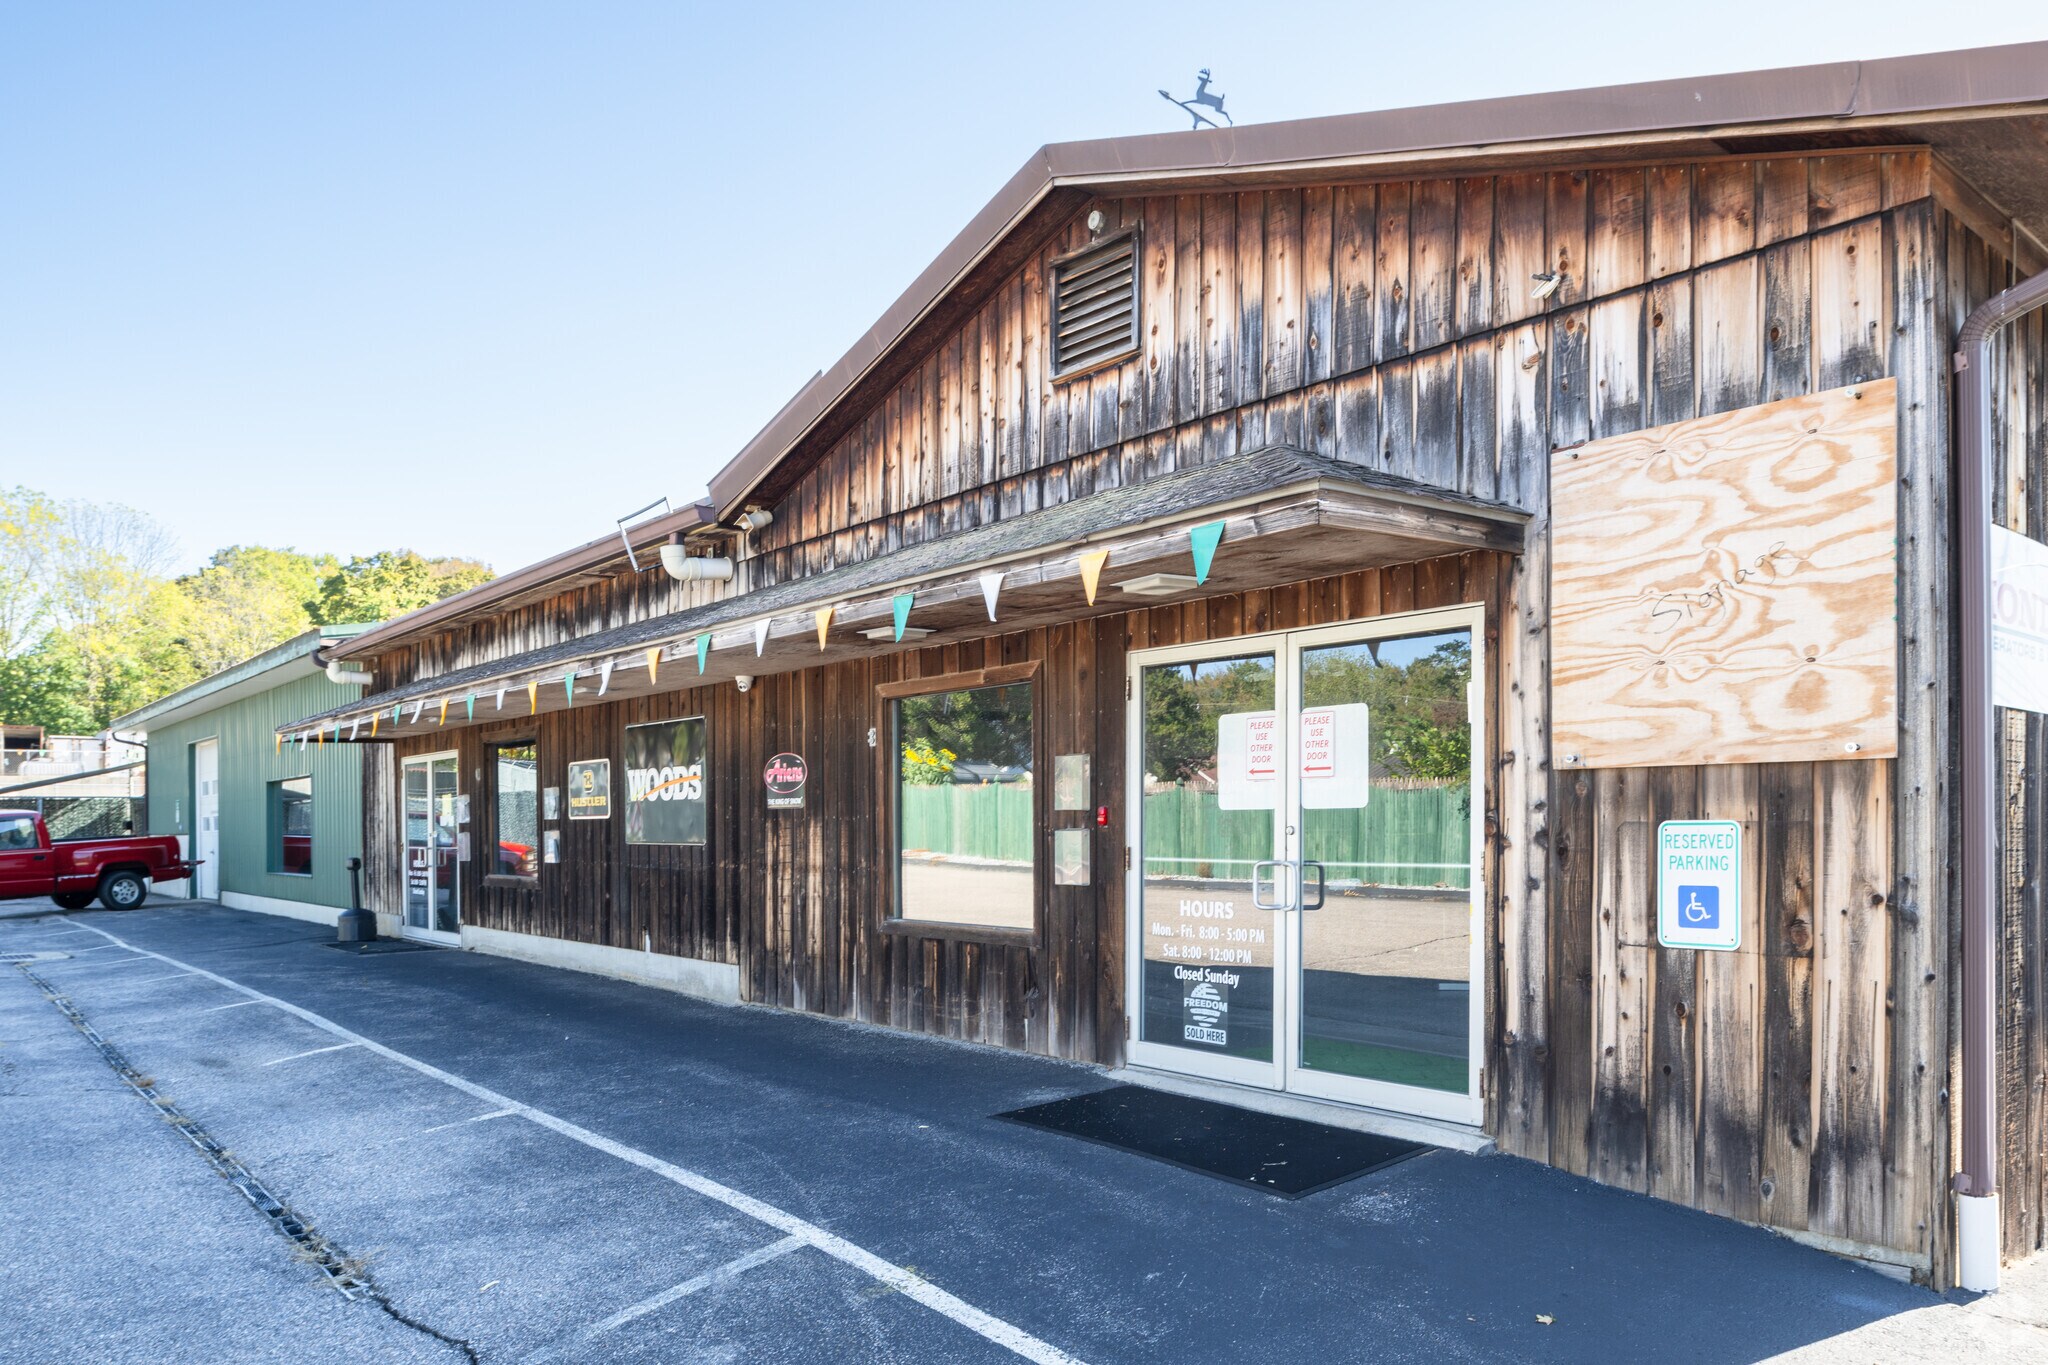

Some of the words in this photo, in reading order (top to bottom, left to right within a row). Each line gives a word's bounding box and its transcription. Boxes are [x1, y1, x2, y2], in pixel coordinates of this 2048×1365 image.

[1652, 541, 1787, 634] Signage
[1992, 580, 2048, 634] ON
[1993, 636, 2036, 660] ERATORS
[1250, 721, 1274, 730] PLEASE
[1304, 716, 1330, 725] PLEASE
[1255, 732, 1268, 741] USE
[1310, 728, 1324, 737] USE
[1250, 744, 1273, 752] OTHER
[1305, 740, 1329, 748] OTHER
[1251, 755, 1271, 763] DOOR
[1306, 751, 1328, 760] DOOR
[766, 759, 803, 783] Ariens
[627, 764, 702, 802] WOODS
[572, 796, 607, 807] HUSTLER
[1664, 833, 1734, 849] RESERVED
[1669, 855, 1729, 871] PARKING
[1180, 900, 1234, 919] HOURS
[1151, 922, 1174, 937] Mon.
[1180, 924, 1196, 938] Fri.
[1199, 926, 1219, 940] 8:00
[1226, 928, 1248, 941] 5:00
[1249, 929, 1265, 943] PM
[1163, 944, 1180, 957] Sat.
[1182, 946, 1202, 959] 8:00
[1209, 948, 1235, 962] 12:00
[1236, 949, 1252, 964] PM
[1174, 966, 1204, 981] Closed
[1204, 968, 1240, 989] Sunday
[1183, 997, 1228, 1013] FREEDOM
[1186, 1027, 1205, 1040] SOLD
[1206, 1029, 1225, 1043] HERE
